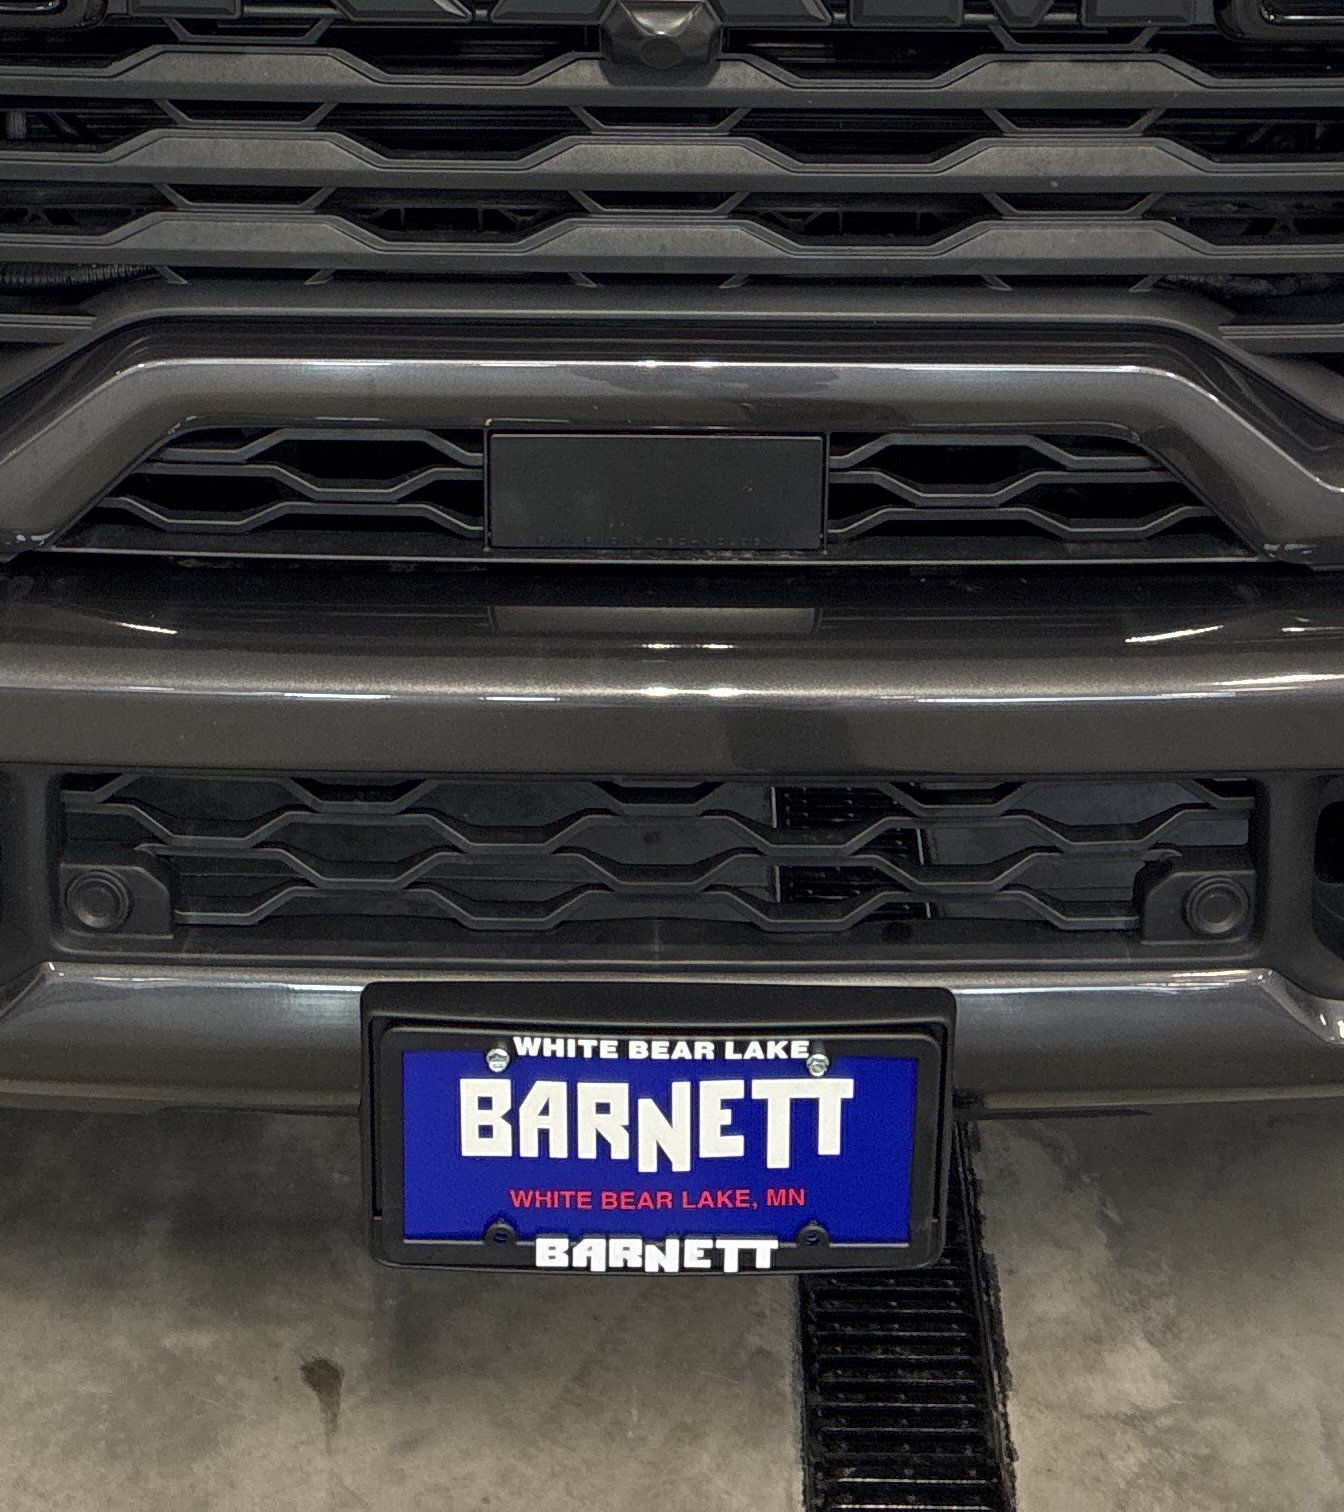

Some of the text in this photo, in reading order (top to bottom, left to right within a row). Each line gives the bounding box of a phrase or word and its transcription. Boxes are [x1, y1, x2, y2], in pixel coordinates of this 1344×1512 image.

[513, 1036, 810, 1060] WHITE BEAR LAKE
[459, 1078, 854, 1172] BARNETT
[510, 1187, 806, 1210] WHITE BEAR LAKE, MN
[535, 1238, 778, 1273] BARNETT
